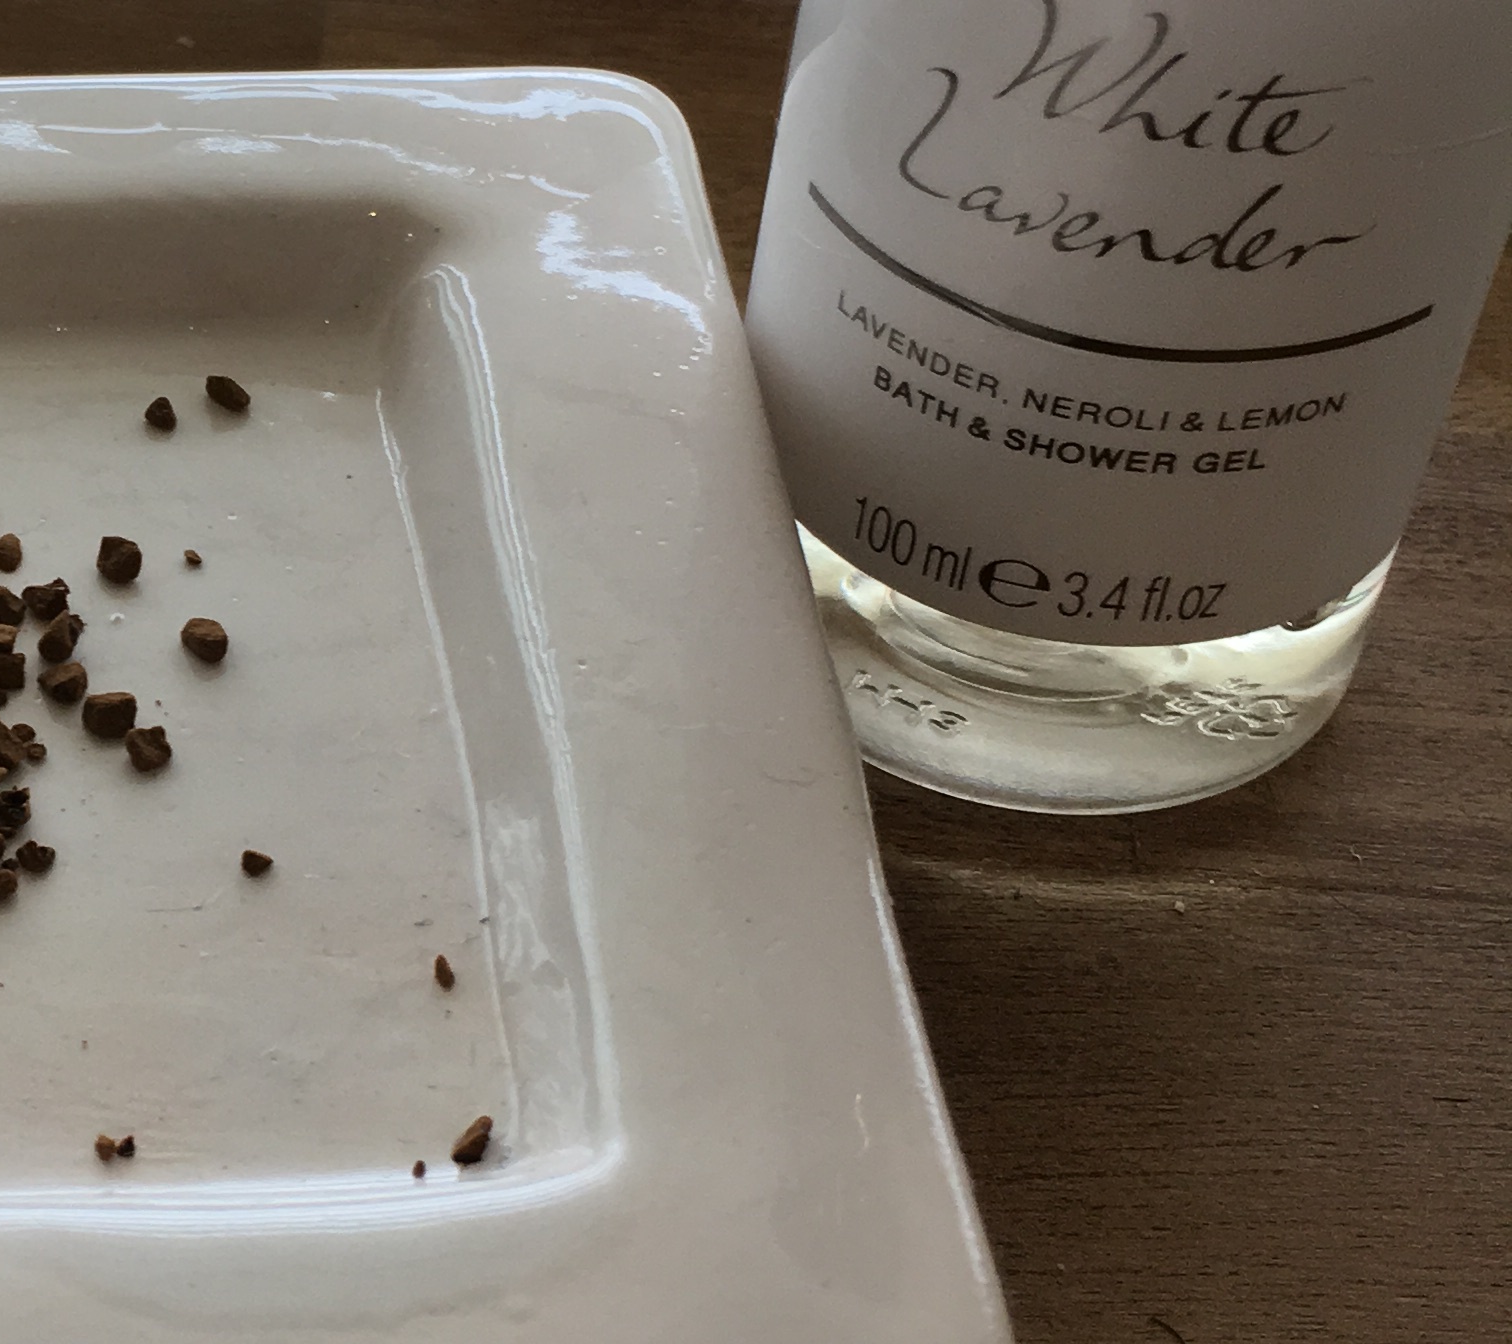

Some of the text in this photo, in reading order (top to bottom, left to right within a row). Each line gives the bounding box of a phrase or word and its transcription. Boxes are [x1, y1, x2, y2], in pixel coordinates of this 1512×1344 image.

[899, 67, 1378, 273] Lavender
[873, 366, 1267, 474] BATH & SHOWER GEL
[1022, 389, 1170, 431] NEROLI
[1180, 413, 1204, 433] &
[1218, 392, 1347, 432] LEMON
[854, 496, 914, 567] 100
[922, 542, 972, 591] ml
[1058, 571, 1128, 621] 3.4
